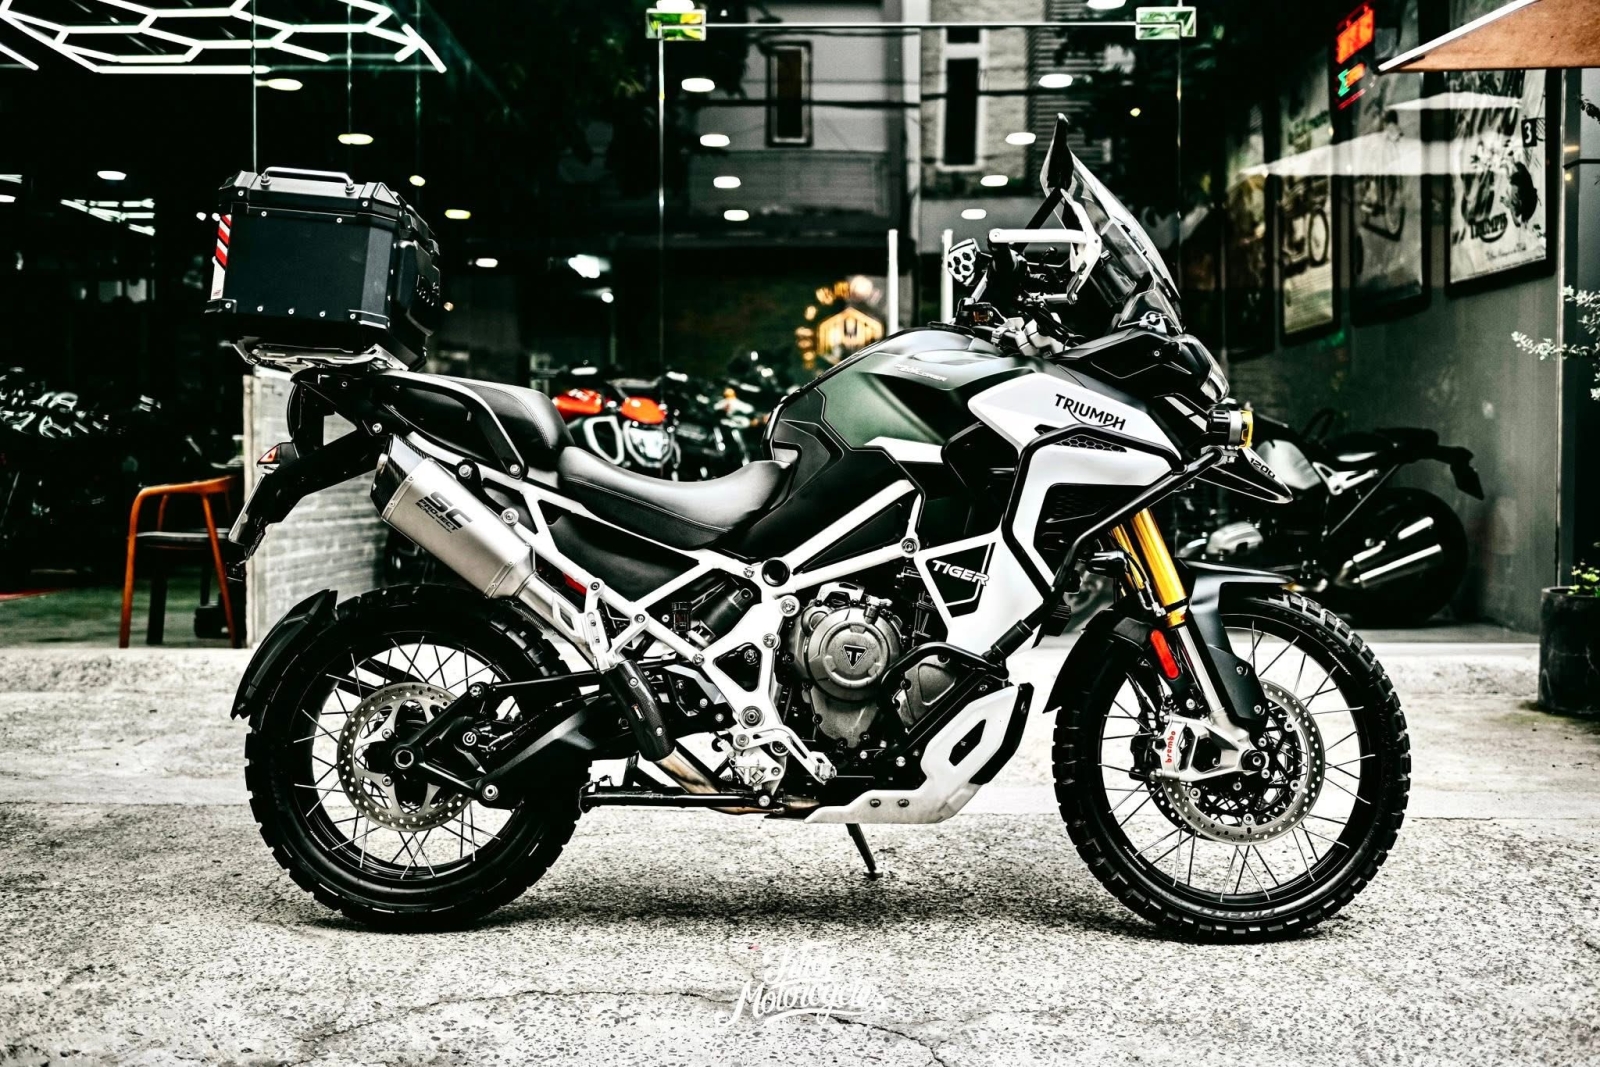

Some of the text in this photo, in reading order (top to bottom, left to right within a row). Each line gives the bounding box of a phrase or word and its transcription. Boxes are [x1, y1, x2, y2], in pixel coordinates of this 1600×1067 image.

[1524, 122, 1532, 144] 3
[1055, 393, 1126, 431] TRIUMPH
[1250, 457, 1276, 479] 1200
[418, 498, 459, 531] PROJECT
[423, 491, 473, 529] SC
[932, 559, 990, 587] TIGER
[1164, 730, 1177, 764] brembo
